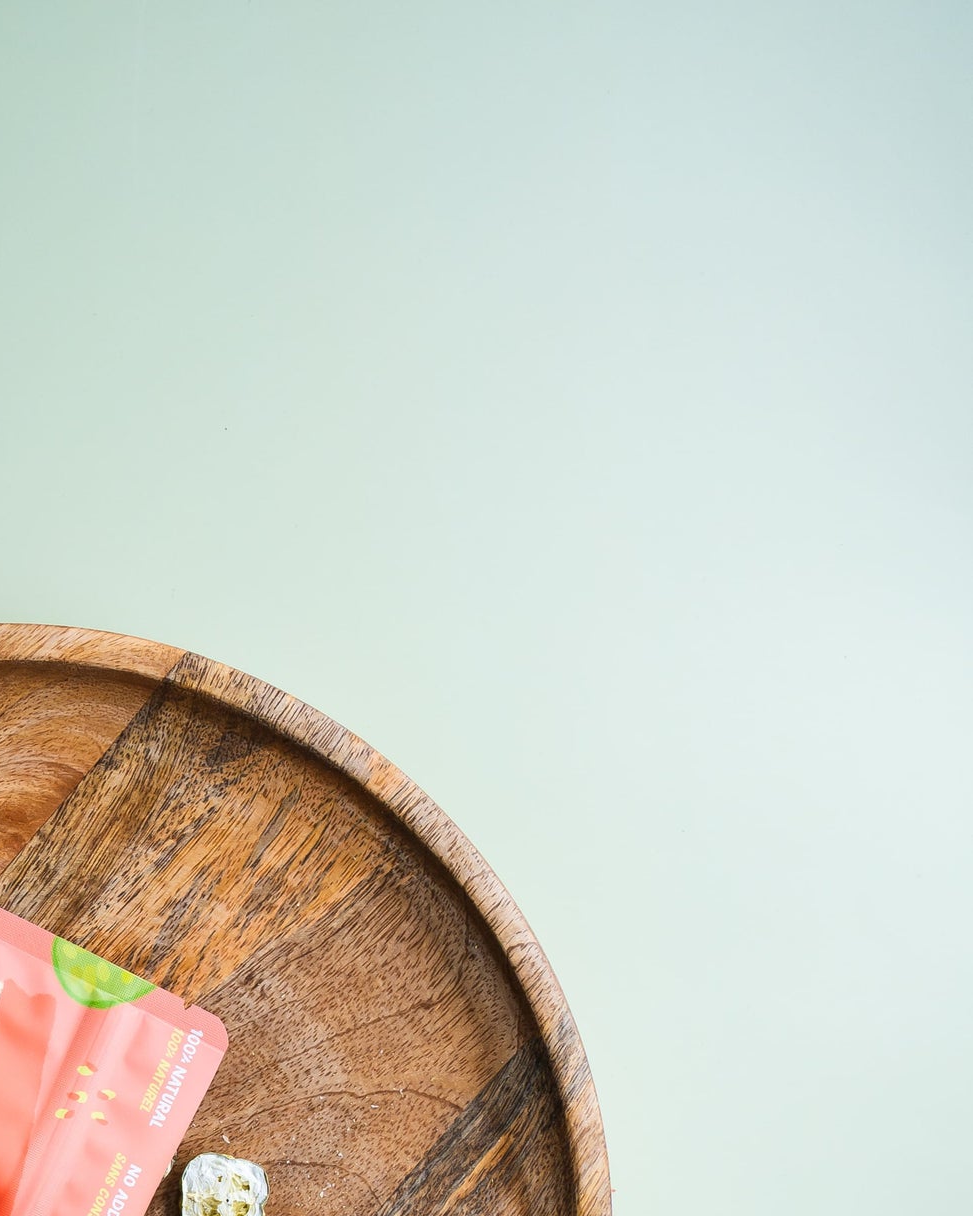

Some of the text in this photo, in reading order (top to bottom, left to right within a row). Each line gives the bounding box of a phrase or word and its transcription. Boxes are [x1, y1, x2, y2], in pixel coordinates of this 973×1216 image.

[139, 1027, 185, 1113] 100% NATUREL
[149, 1028, 204, 1128] 100% NATURAL
[105, 1152, 127, 1188] SANS
[123, 1163, 142, 1188] NO
